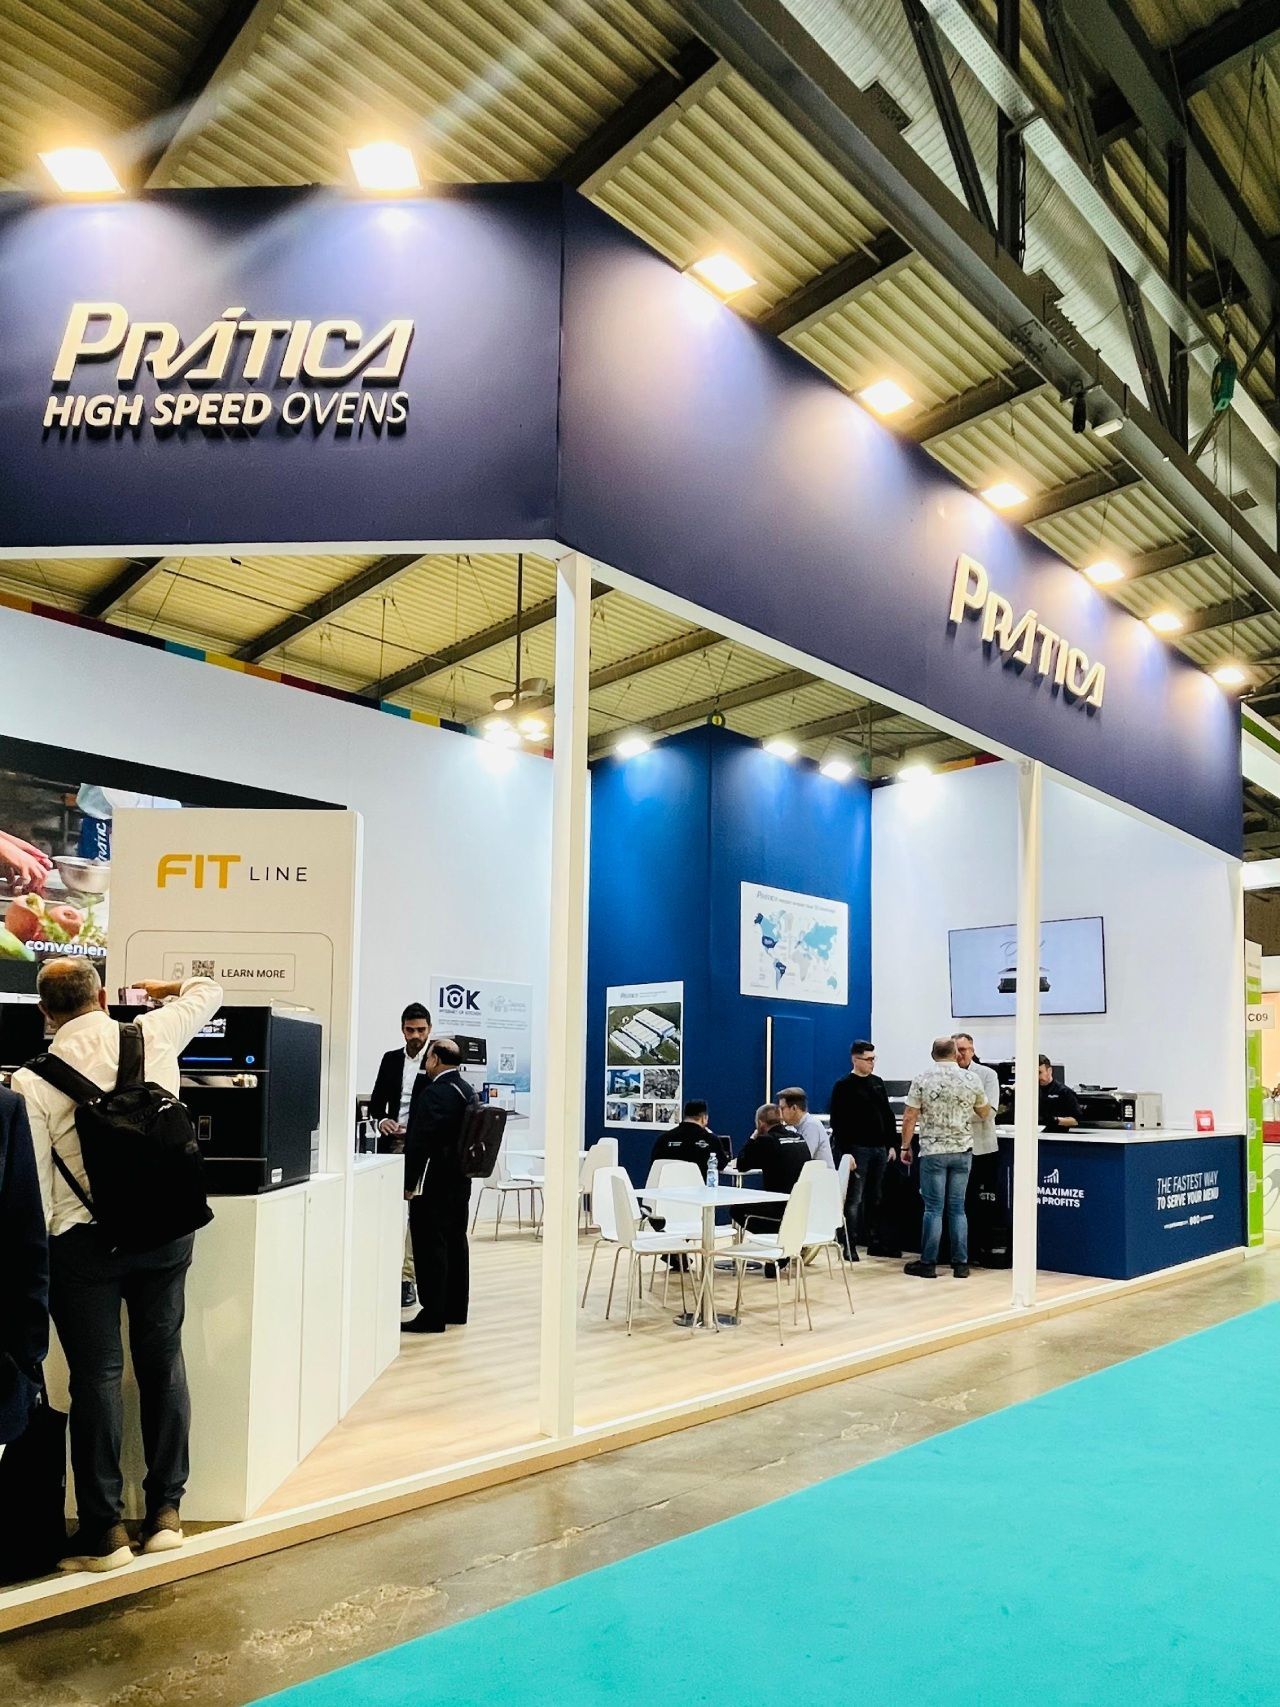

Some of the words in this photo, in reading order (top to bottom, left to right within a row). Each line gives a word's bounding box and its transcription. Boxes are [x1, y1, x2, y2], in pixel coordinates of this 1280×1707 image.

[43, 394, 143, 427] HIGH
[150, 393, 272, 426] SPEED
[282, 391, 409, 425] OVENS
[157, 854, 241, 889] FIT
[250, 866, 307, 882] LINE
[221, 969, 254, 978] LEARN
[256, 969, 286, 979] MORE
[439, 984, 481, 1010] IOK
[1247, 1013, 1269, 1022] C09
[1036, 1186, 1085, 1198] MAXIMIZE
[1157, 1177, 1172, 1195] THE
[1173, 1172, 1203, 1193] FASTEST
[1204, 1170, 1219, 1187] WAY
[1042, 1196, 1081, 1208] PROFITS
[1157, 1196, 1166, 1210] TO
[1167, 1192, 1186, 1209] SERVE
[1187, 1190, 1202, 1205] YOUR
[1203, 1187, 1219, 1201] MENU
